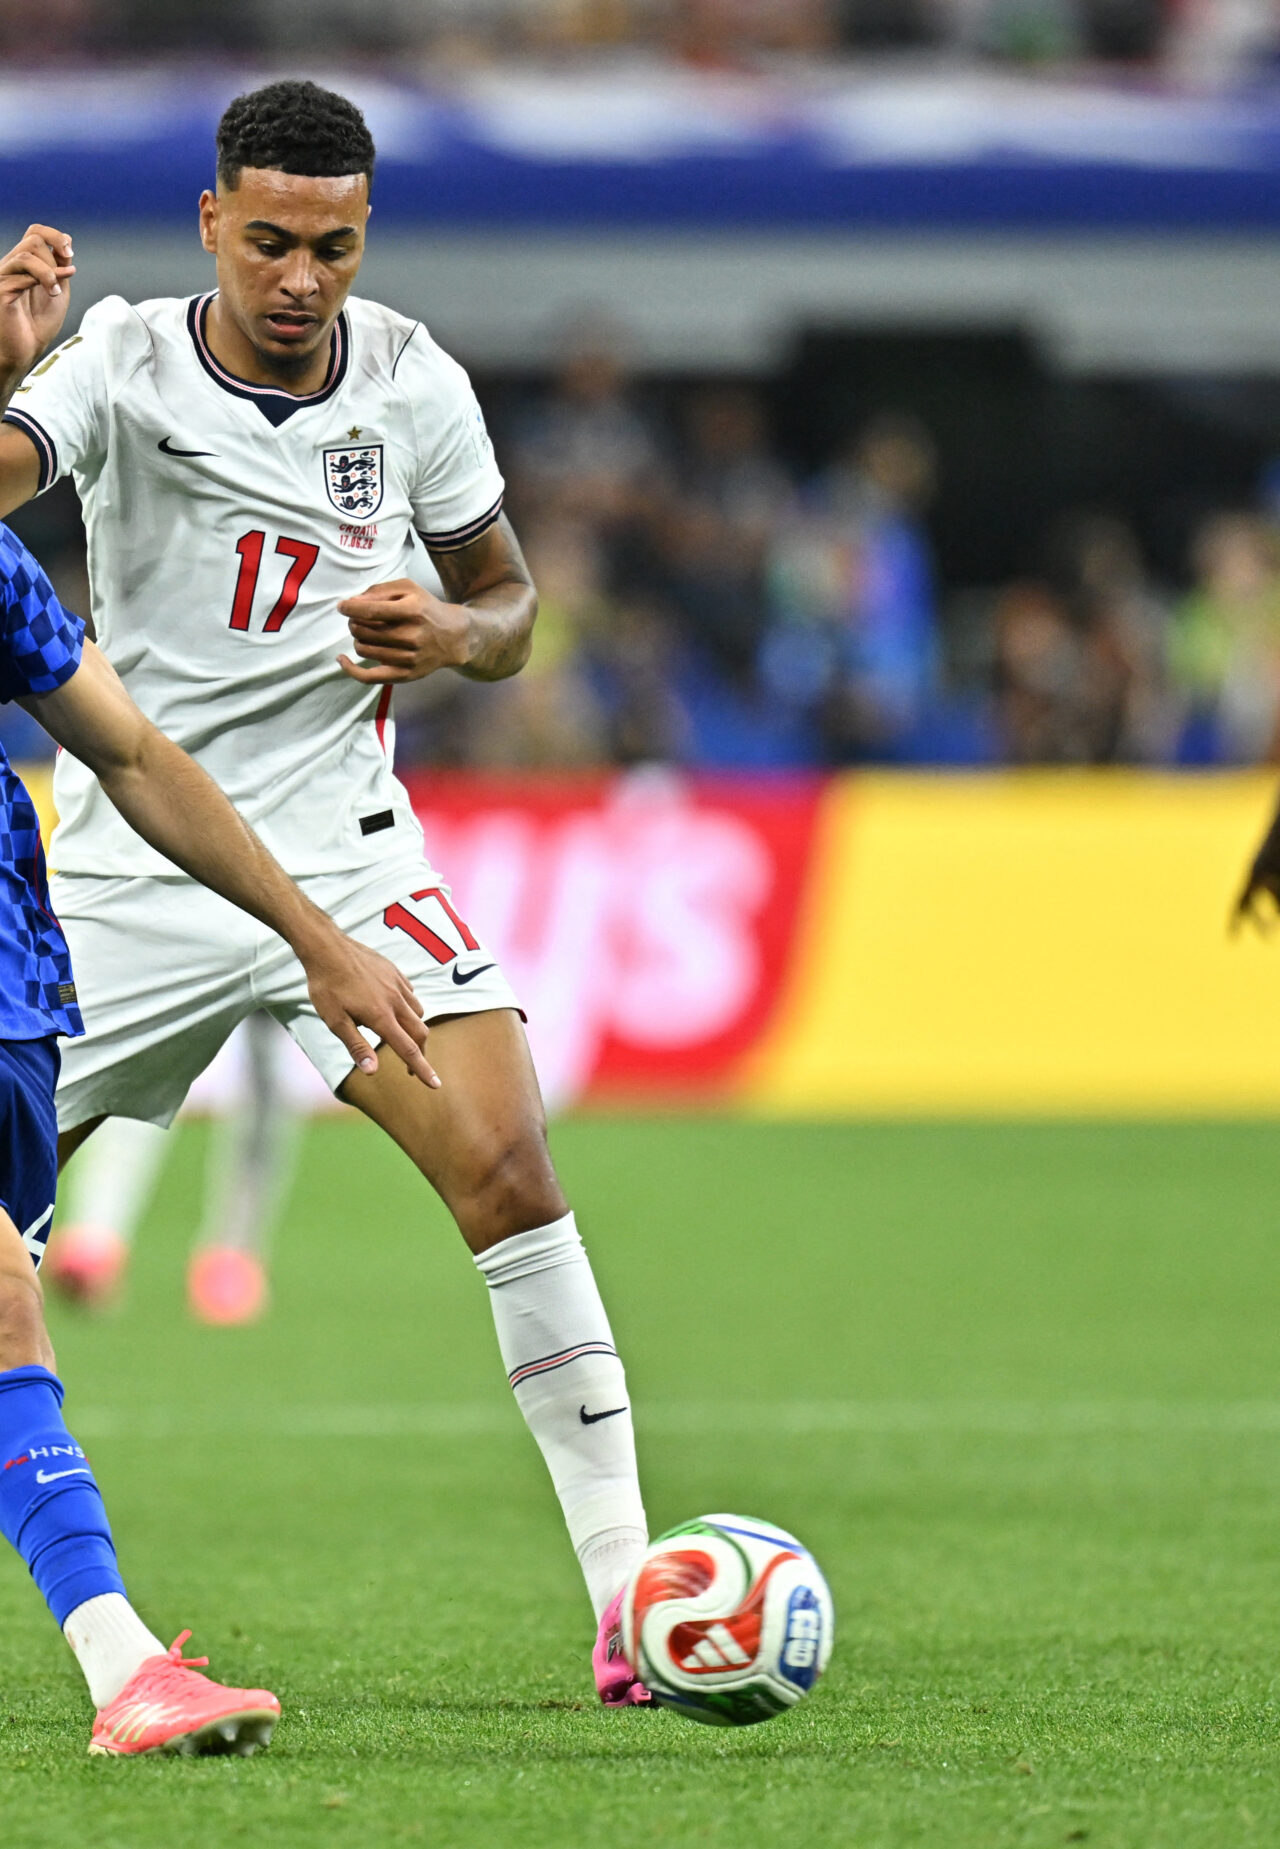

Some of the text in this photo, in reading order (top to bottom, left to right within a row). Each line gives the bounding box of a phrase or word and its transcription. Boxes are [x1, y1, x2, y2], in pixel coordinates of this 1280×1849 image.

[339, 523, 378, 537] CROATIA
[339, 534, 374, 550] 17.06.26
[228, 529, 320, 632] 17
[383, 887, 481, 965] 17
[28, 1445, 85, 1460] HNS
